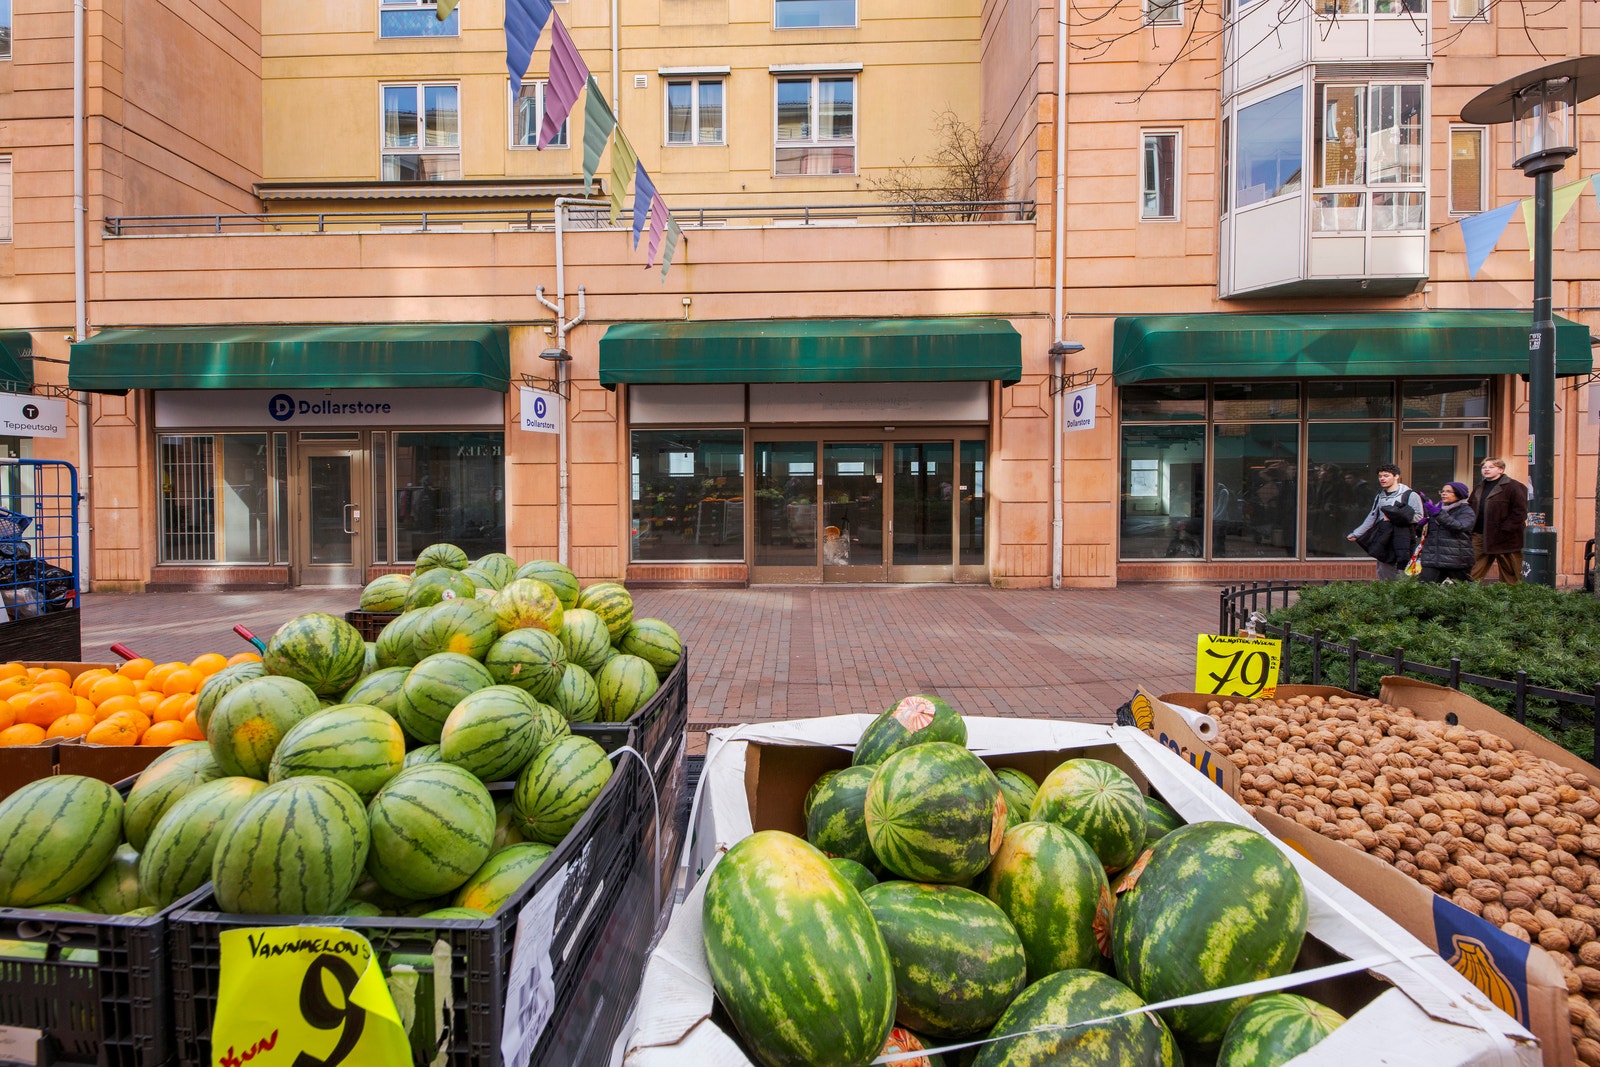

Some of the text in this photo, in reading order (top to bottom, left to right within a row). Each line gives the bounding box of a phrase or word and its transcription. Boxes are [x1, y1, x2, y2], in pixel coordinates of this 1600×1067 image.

[299, 400, 391, 414] Dollarstore
[3, 420, 58, 433] Teppeutsalg
[526, 418, 555, 429] Dollarstore
[1066, 418, 1091, 428] Dollarstore
[1205, 648, 1270, 698] 79
[291, 953, 366, 1067] 9
